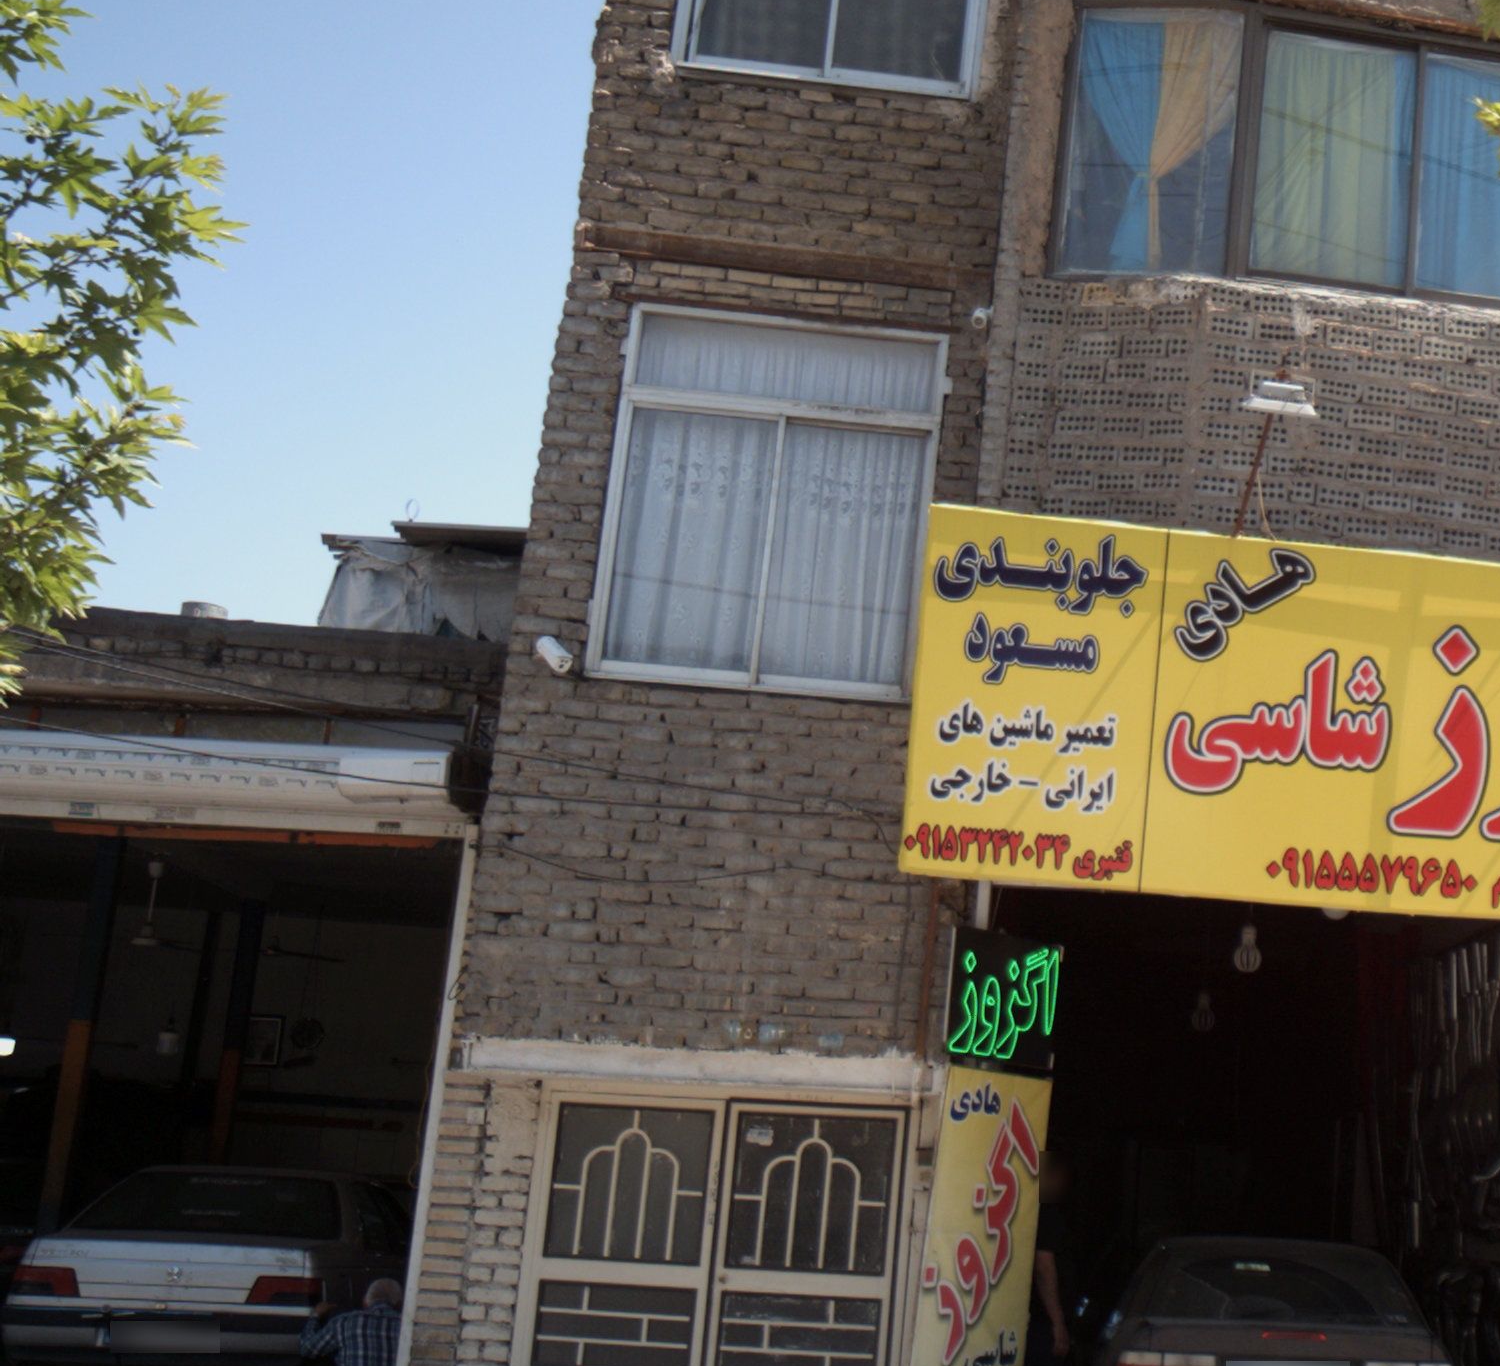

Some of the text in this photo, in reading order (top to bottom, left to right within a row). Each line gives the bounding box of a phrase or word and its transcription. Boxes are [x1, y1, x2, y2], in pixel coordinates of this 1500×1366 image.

[935, 535, 1148, 617] جلوبندی
[1173, 548, 1316, 661] هادی
[965, 612, 1099, 685] مسعود
[938, 701, 1118, 754] تعمیر ماشین های
[1164, 648, 1391, 794] شاسی
[929, 758, 1014, 804] خارجی
[1044, 767, 1116, 812] ایرانی
[903, 822, 1134, 881] قنبری ۰۹۱۵۳۲۴۲۰۳۴
[1266, 847, 1479, 899] ۰۹۱۵۵۵۷۹۶۵۰
[948, 947, 1061, 1060] اگزوز
[950, 1083, 1001, 1122] هادی
